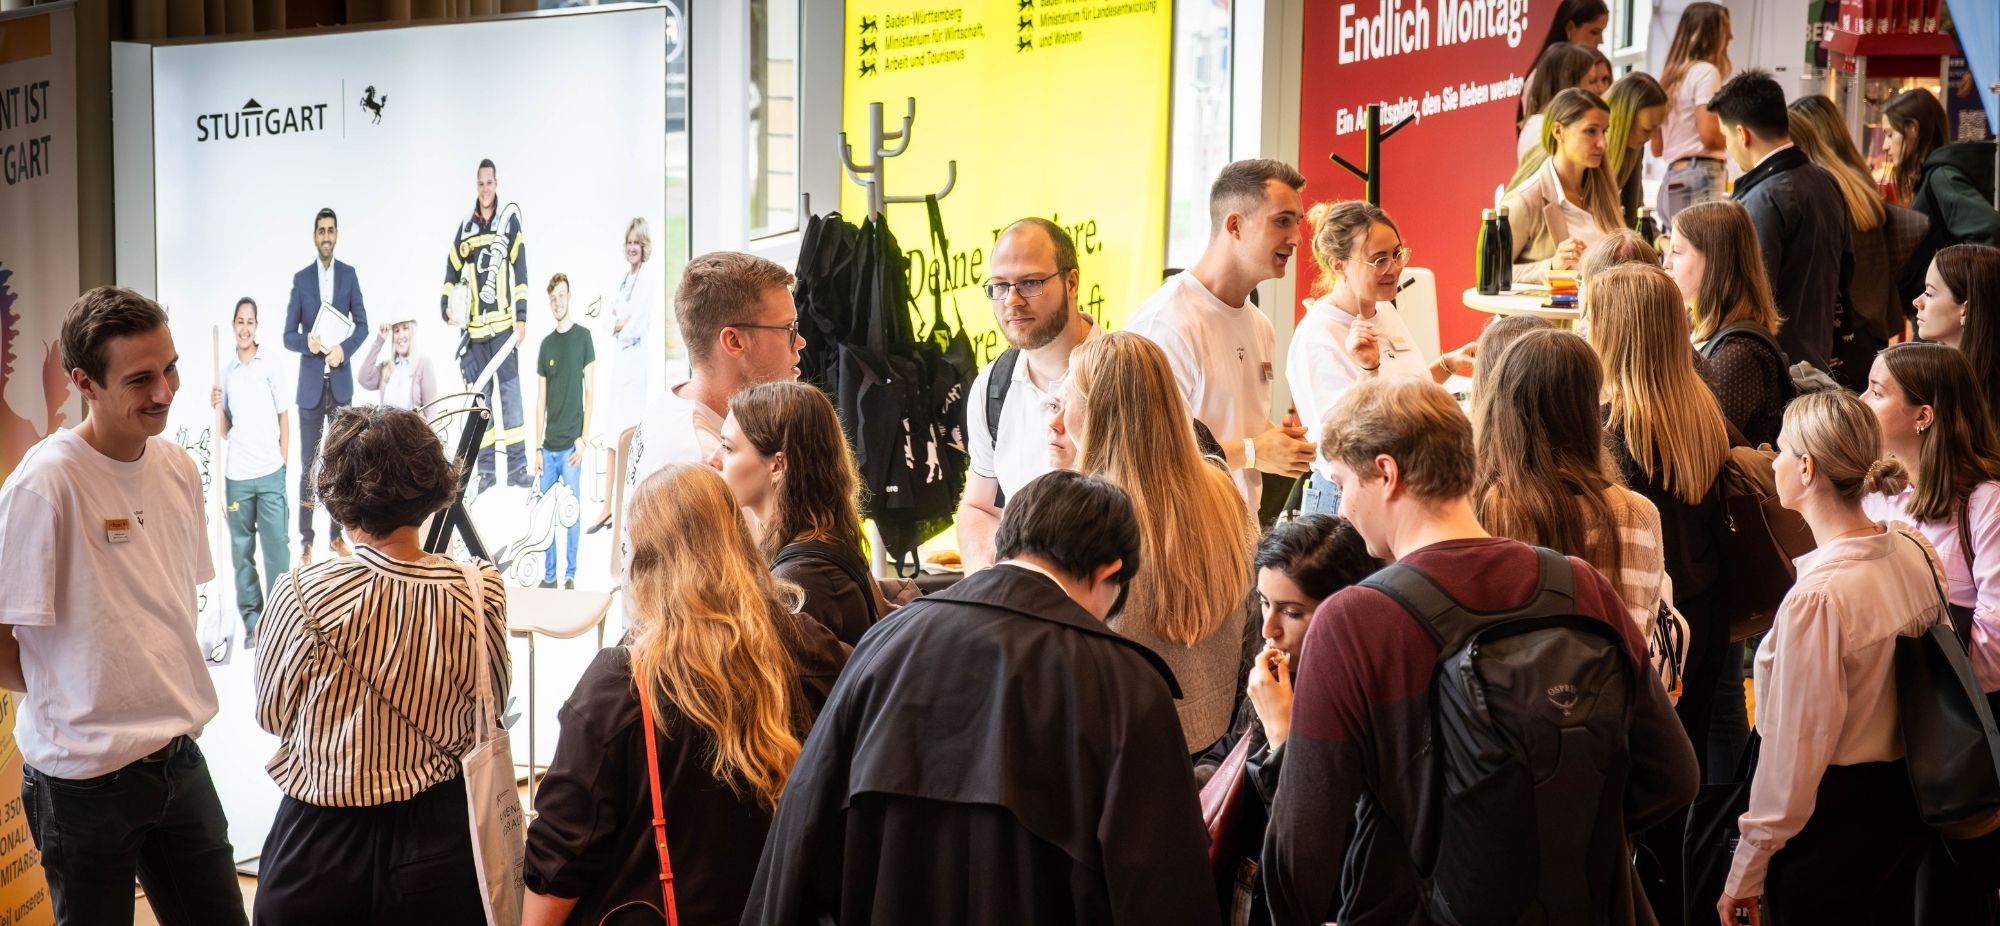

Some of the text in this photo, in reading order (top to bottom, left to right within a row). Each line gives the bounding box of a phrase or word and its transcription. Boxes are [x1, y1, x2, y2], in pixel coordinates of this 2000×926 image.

[1040, 11, 1080, 27] Ministerium
[1338, 0, 1529, 64] Endlich Montag!
[885, 33, 930, 50] Ministerium
[932, 29, 943, 43] für
[1039, 34, 1053, 48] und
[884, 48, 965, 71] Arbeit und Tourismus
[24, 80, 50, 124] IST
[1336, 72, 1524, 136] Ein Aritsplatz, den Sie lieben werden
[197, 98, 328, 142] STUTTGART
[0, 135, 51, 186] GART
[4, 796, 21, 823] 350
[14, 887, 45, 922] unseres
